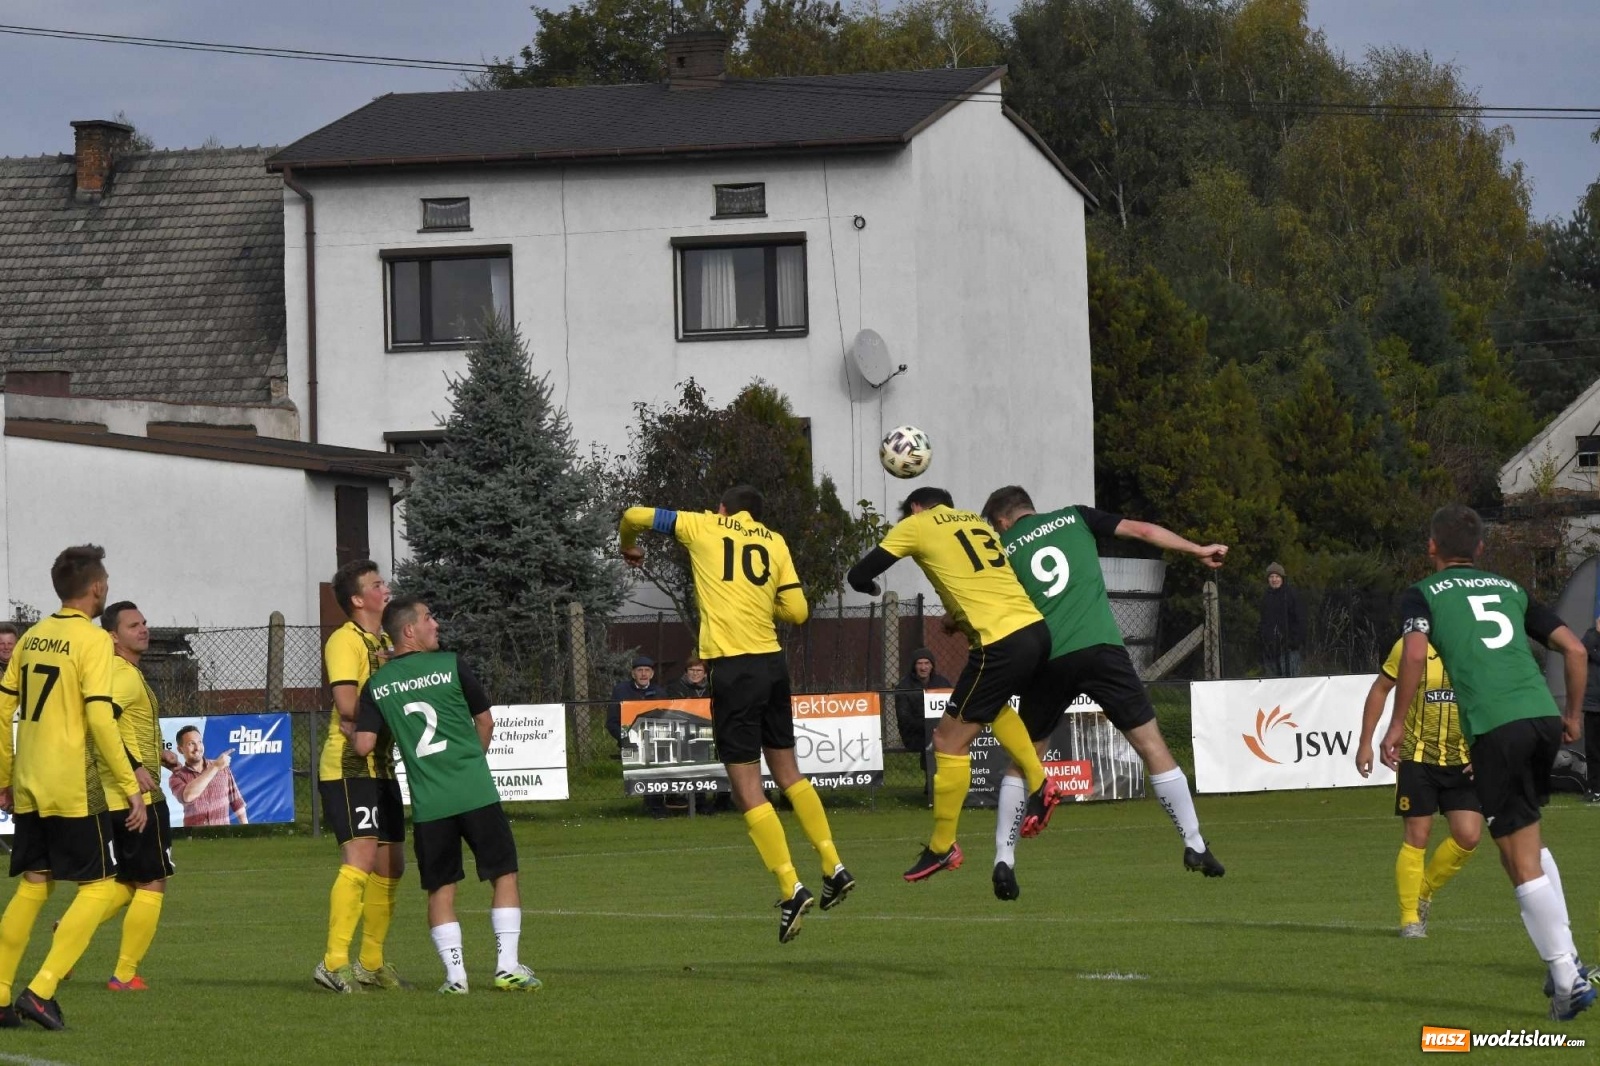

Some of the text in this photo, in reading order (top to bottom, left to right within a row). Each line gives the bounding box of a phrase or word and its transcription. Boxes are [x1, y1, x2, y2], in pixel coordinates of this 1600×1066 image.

[722, 536, 771, 586] 10
[954, 528, 1006, 573] 13
[1004, 542, 1017, 557] KS
[1030, 546, 1070, 598] 9
[1429, 579, 1454, 595] LKS
[1467, 594, 1514, 649] 5
[21, 663, 60, 722] 17
[373, 671, 452, 700] LKS TWORKÓW
[792, 697, 868, 718] jektowe
[403, 701, 448, 758] 2
[1294, 730, 1352, 763] JSW
[647, 780, 718, 793] 509 576 946
[810, 775, 854, 788] Asnyka
[856, 774, 872, 785] 69
[1399, 796, 1411, 811] 8
